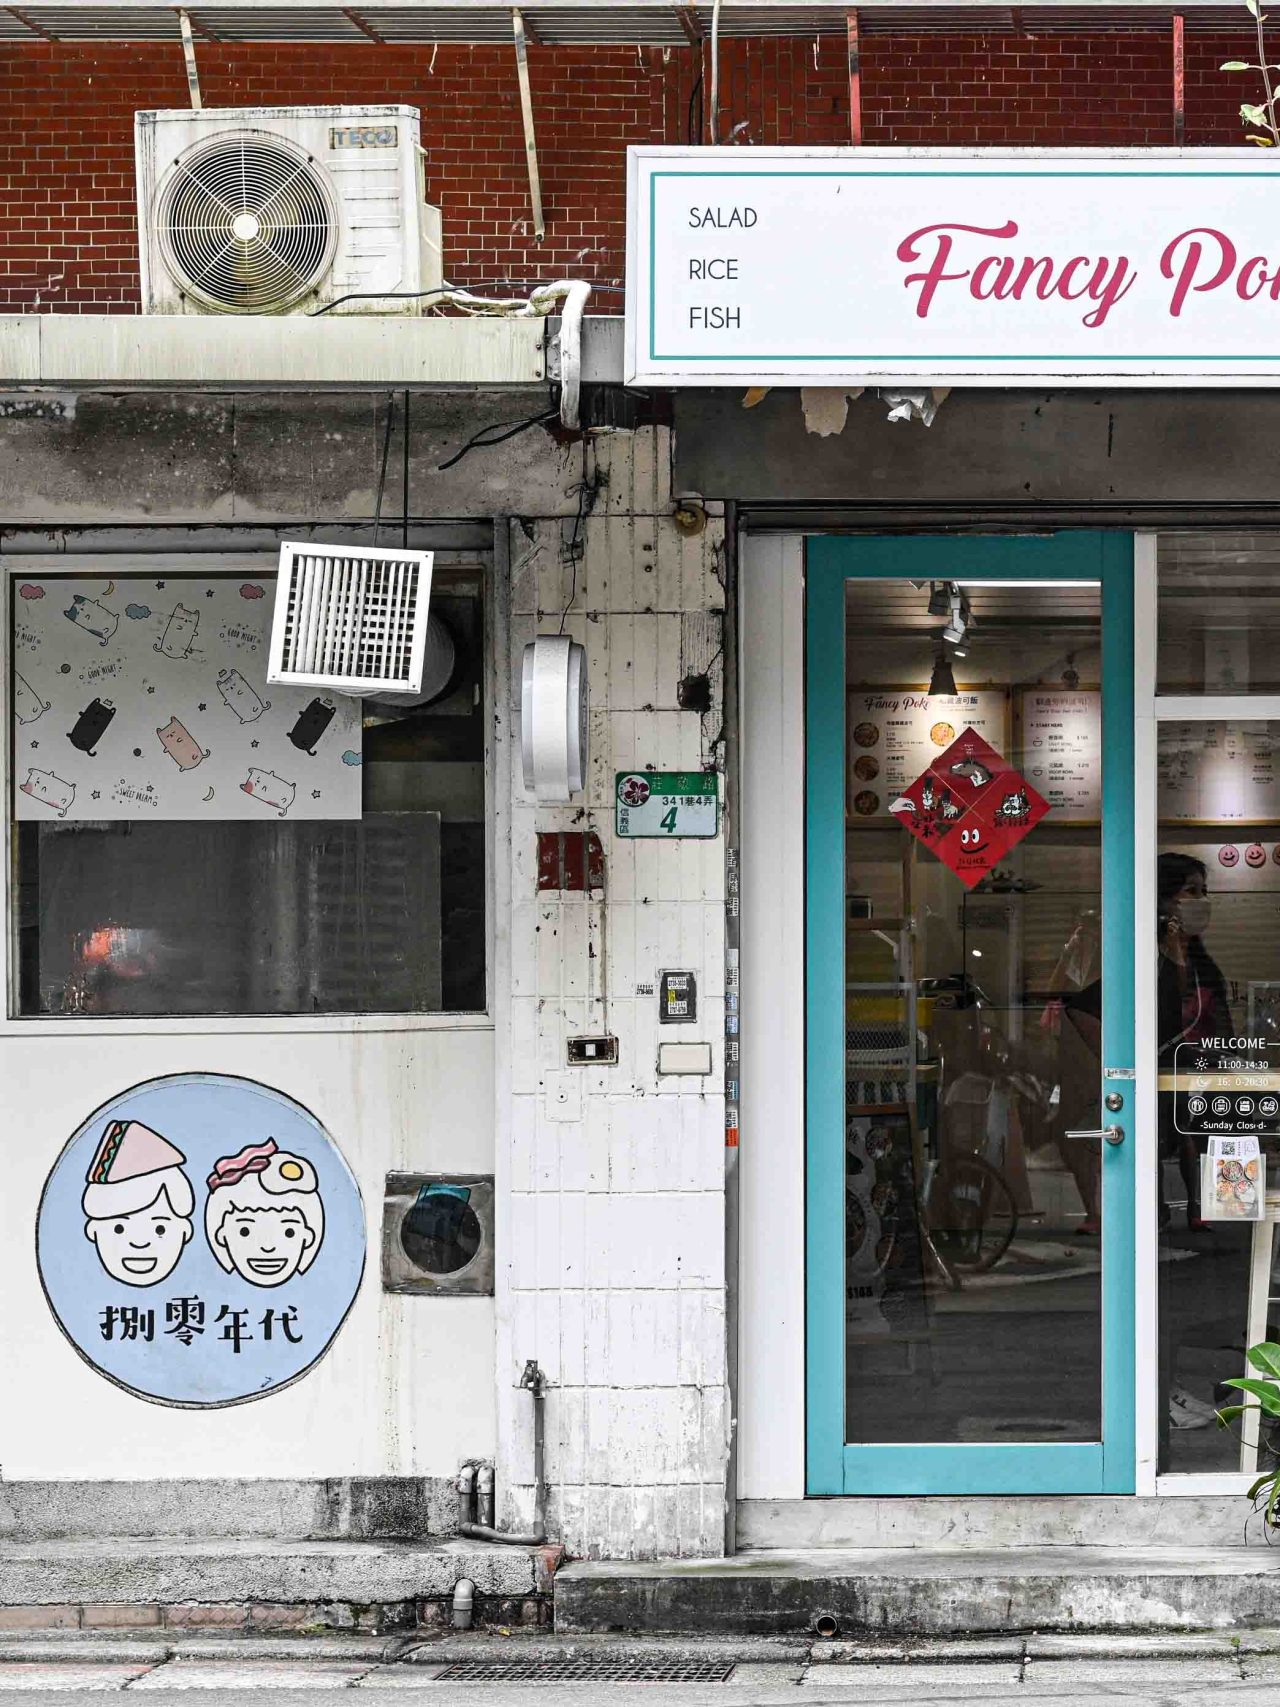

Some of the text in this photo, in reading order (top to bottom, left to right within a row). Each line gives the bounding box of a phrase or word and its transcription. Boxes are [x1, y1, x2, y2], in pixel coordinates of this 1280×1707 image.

[688, 206, 758, 228] SALAD
[689, 258, 739, 280] RICE
[896, 219, 1137, 328] Fancy
[689, 306, 741, 329] FISH
[659, 806, 679, 833] 4
[1201, 1037, 1266, 1049] WELCOME
[1217, 1060, 1269, 1070] 11:00-14:30
[98, 1294, 303, 1354] 捌零年代
